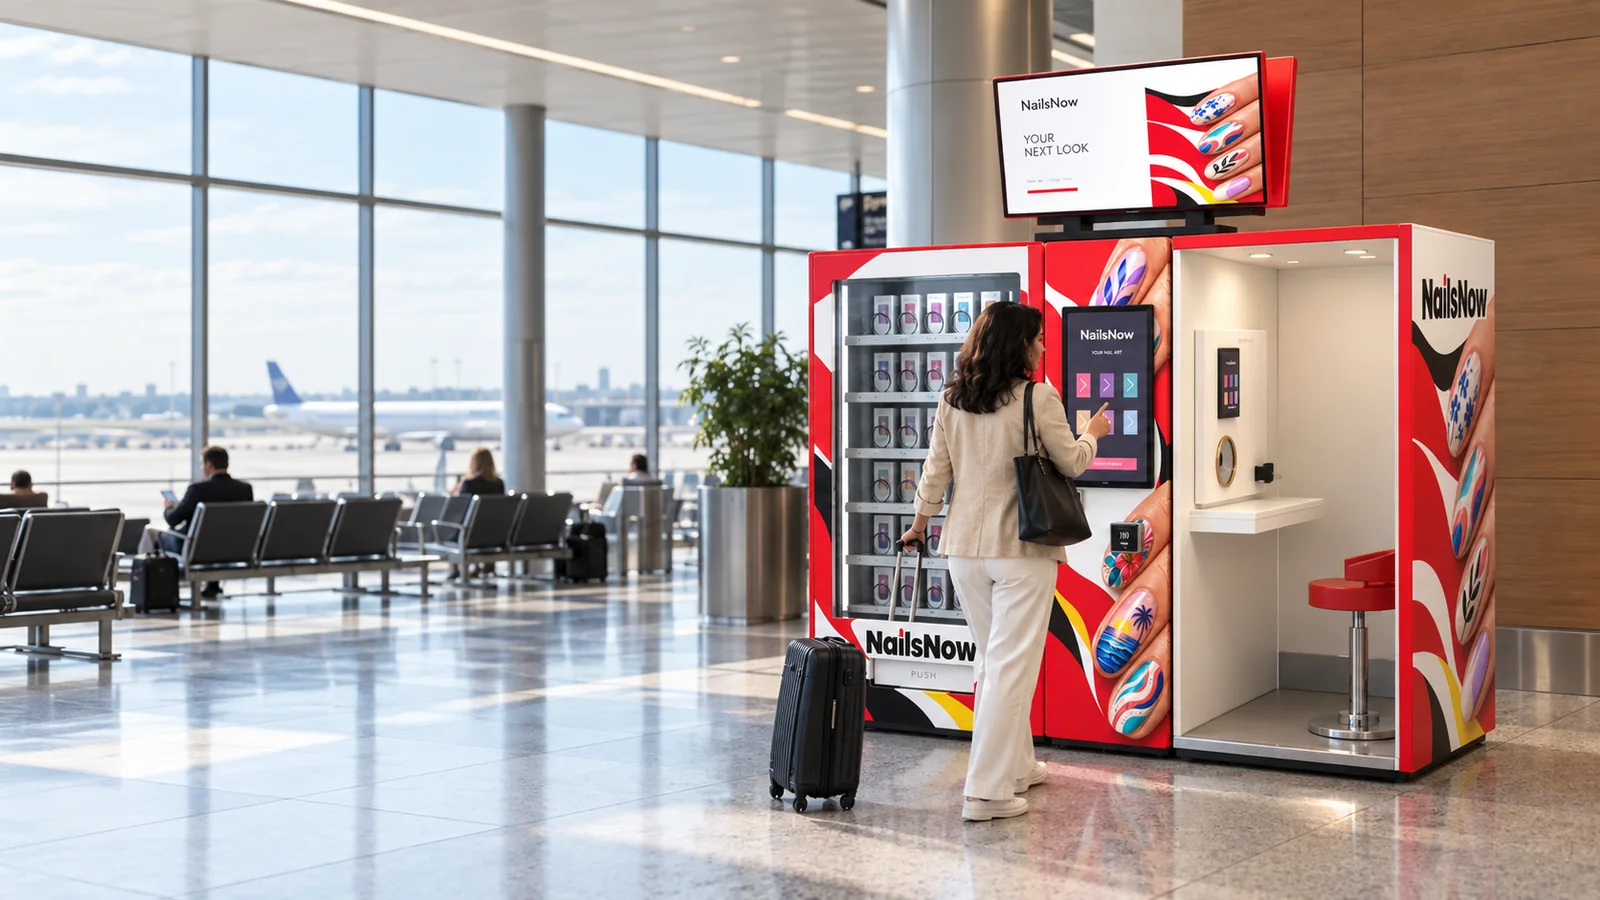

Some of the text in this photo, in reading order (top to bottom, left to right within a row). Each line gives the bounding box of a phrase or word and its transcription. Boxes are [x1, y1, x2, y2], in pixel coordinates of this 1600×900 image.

[1021, 97, 1079, 111] NailsNow
[1023, 133, 1055, 144] YOUR
[1024, 143, 1089, 157] NEXT LOOK
[1421, 273, 1488, 320] NailsNow
[1080, 329, 1135, 341] NailsNow
[866, 627, 977, 662] NailsNow
[911, 670, 937, 680] PUSH
